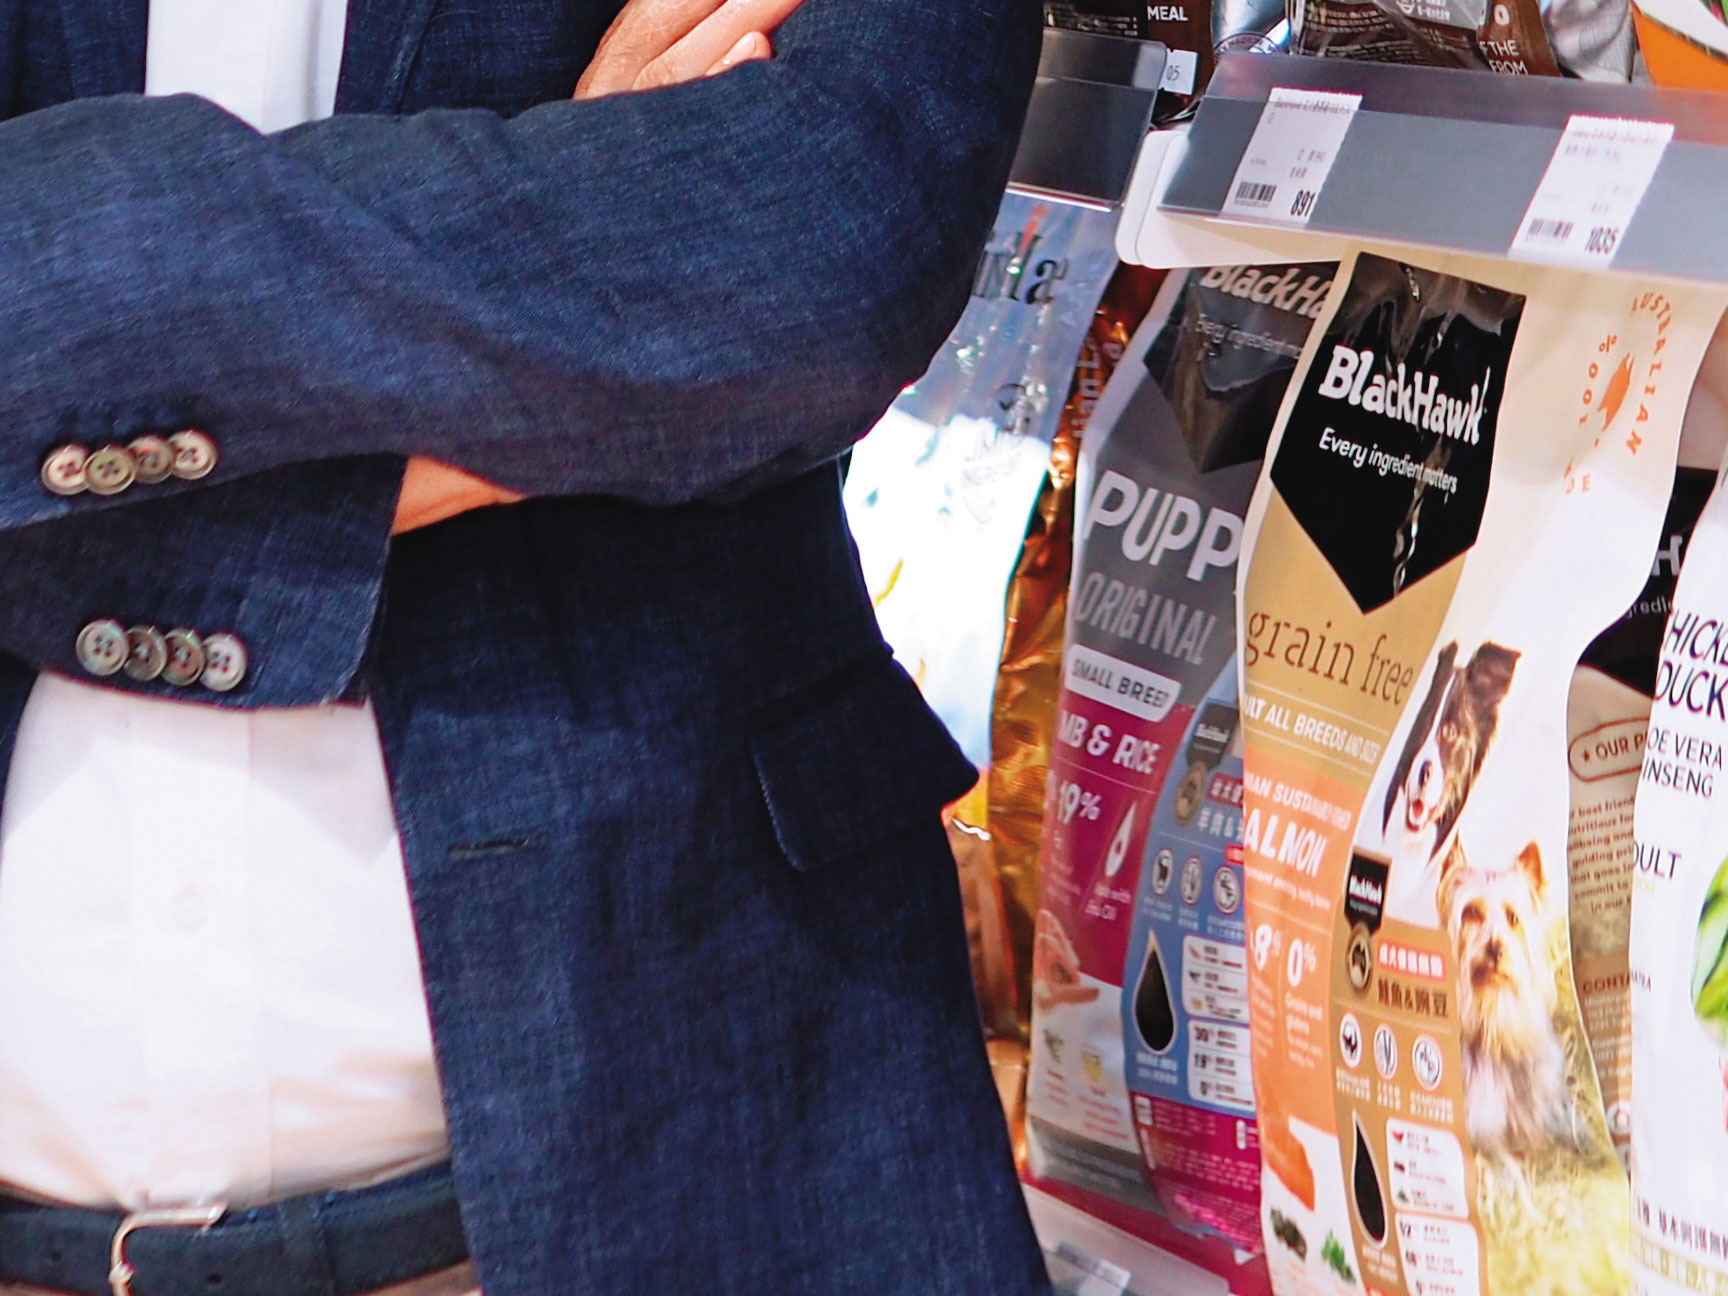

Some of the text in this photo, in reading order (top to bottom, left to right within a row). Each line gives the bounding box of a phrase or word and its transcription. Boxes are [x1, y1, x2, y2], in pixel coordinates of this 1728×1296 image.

[1147, 5, 1189, 22] MEAL
[1490, 39, 1520, 57] THE
[1289, 189, 1315, 218] 891
[1585, 225, 1619, 256] 1035
[1317, 342, 1489, 445] BlackHawk
[1318, 426, 1369, 469] Every
[1368, 441, 1425, 485] ingredient
[1082, 468, 1246, 582] PUPP
[1075, 569, 1218, 666] ORIGINAL
[1245, 608, 1416, 707] grain free
[1264, 704, 1292, 732] ALL
[1293, 715, 1347, 756] BREEDS
[1594, 736, 1630, 760] OUR
[1112, 732, 1162, 775] RICE
[1673, 733, 1724, 772] VERA
[1641, 757, 1715, 798] INSENG
[1243, 807, 1329, 879] ALMON
